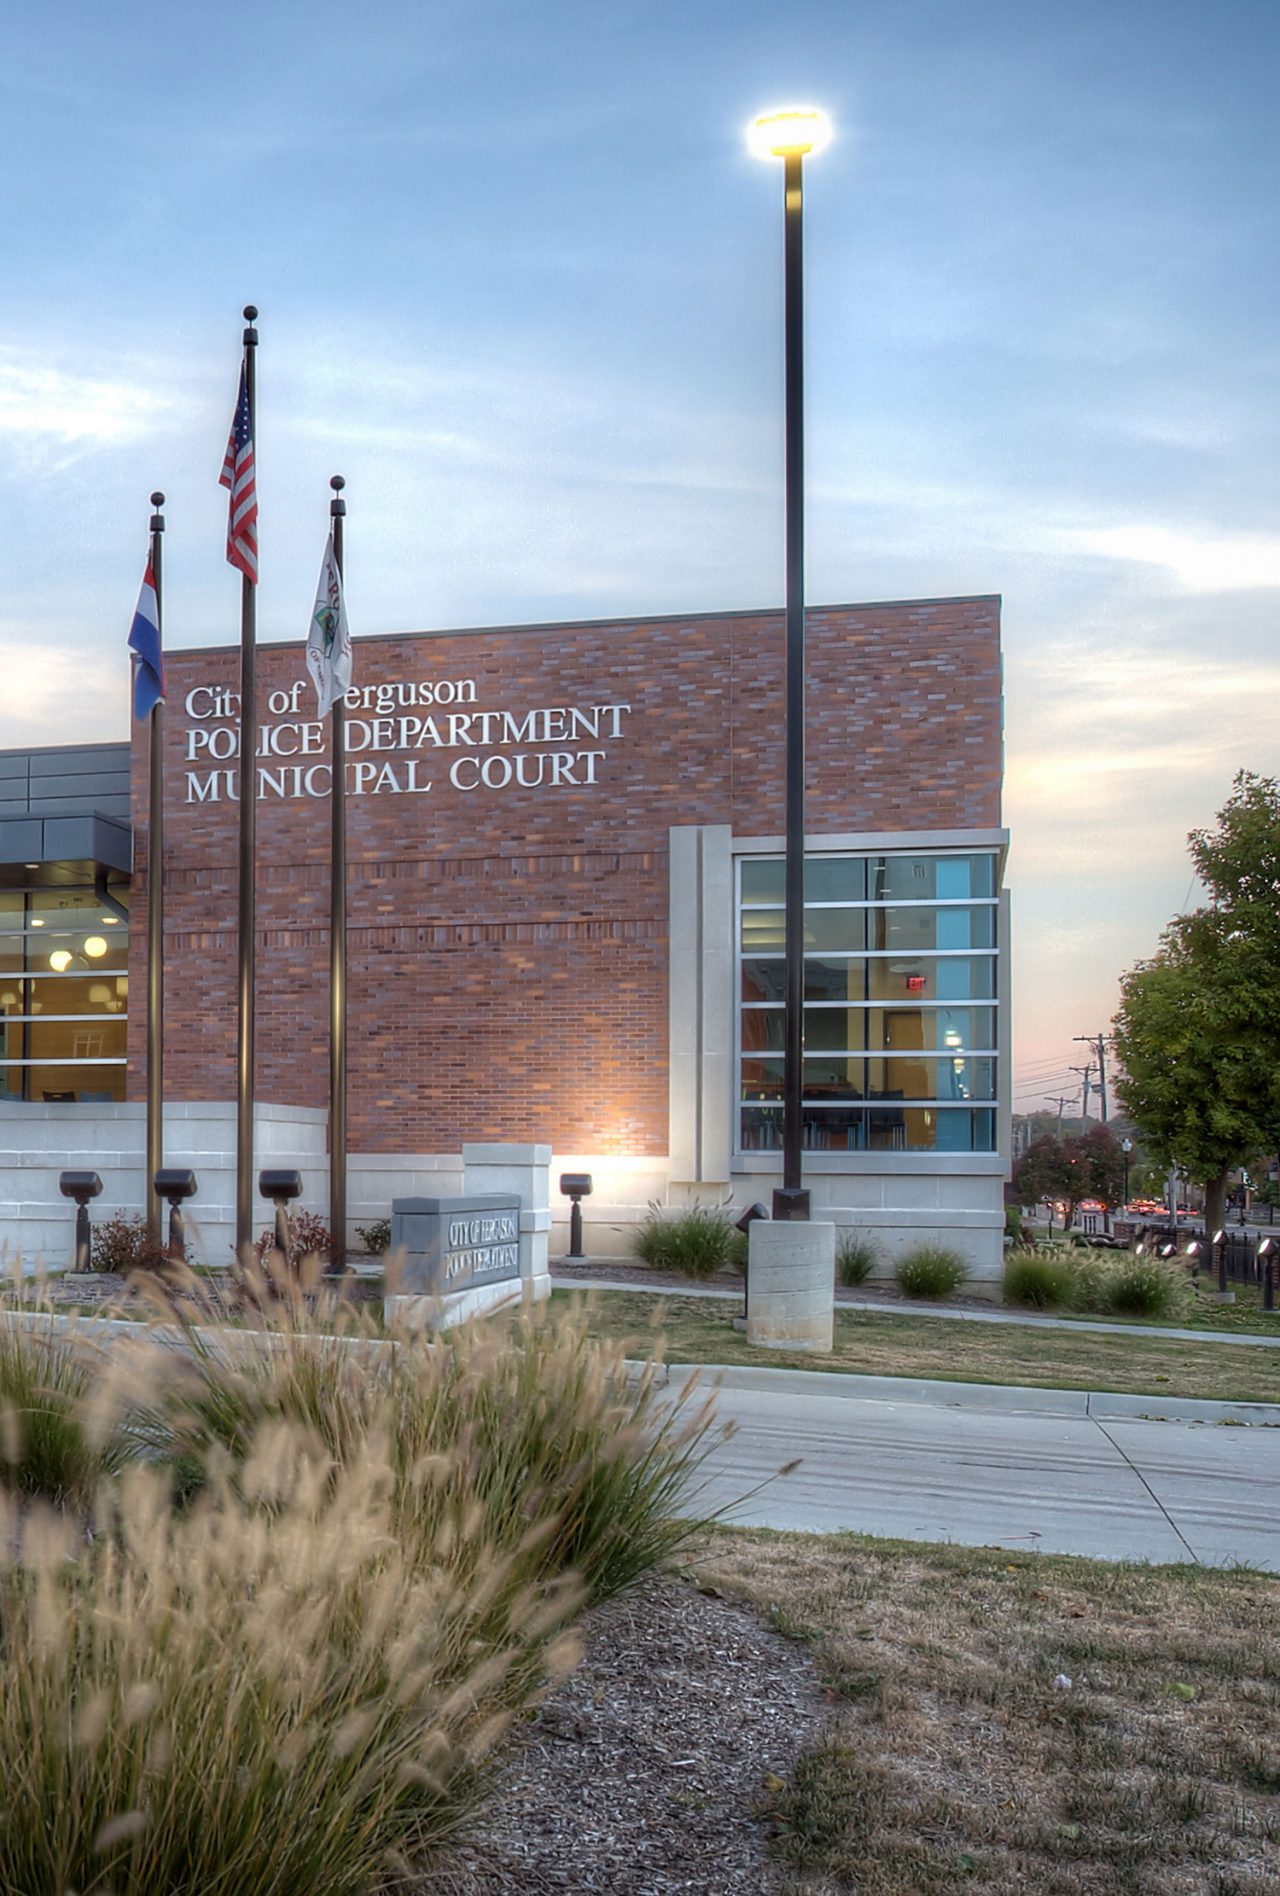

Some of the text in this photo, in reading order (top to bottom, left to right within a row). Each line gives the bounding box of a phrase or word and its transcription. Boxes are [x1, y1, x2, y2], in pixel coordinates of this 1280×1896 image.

[268, 681, 307, 714] of
[328, 679, 478, 715] erguson
[344, 704, 631, 752] DEPARTMENT
[449, 751, 606, 790] COURT
[449, 1221, 469, 1246] CITY
